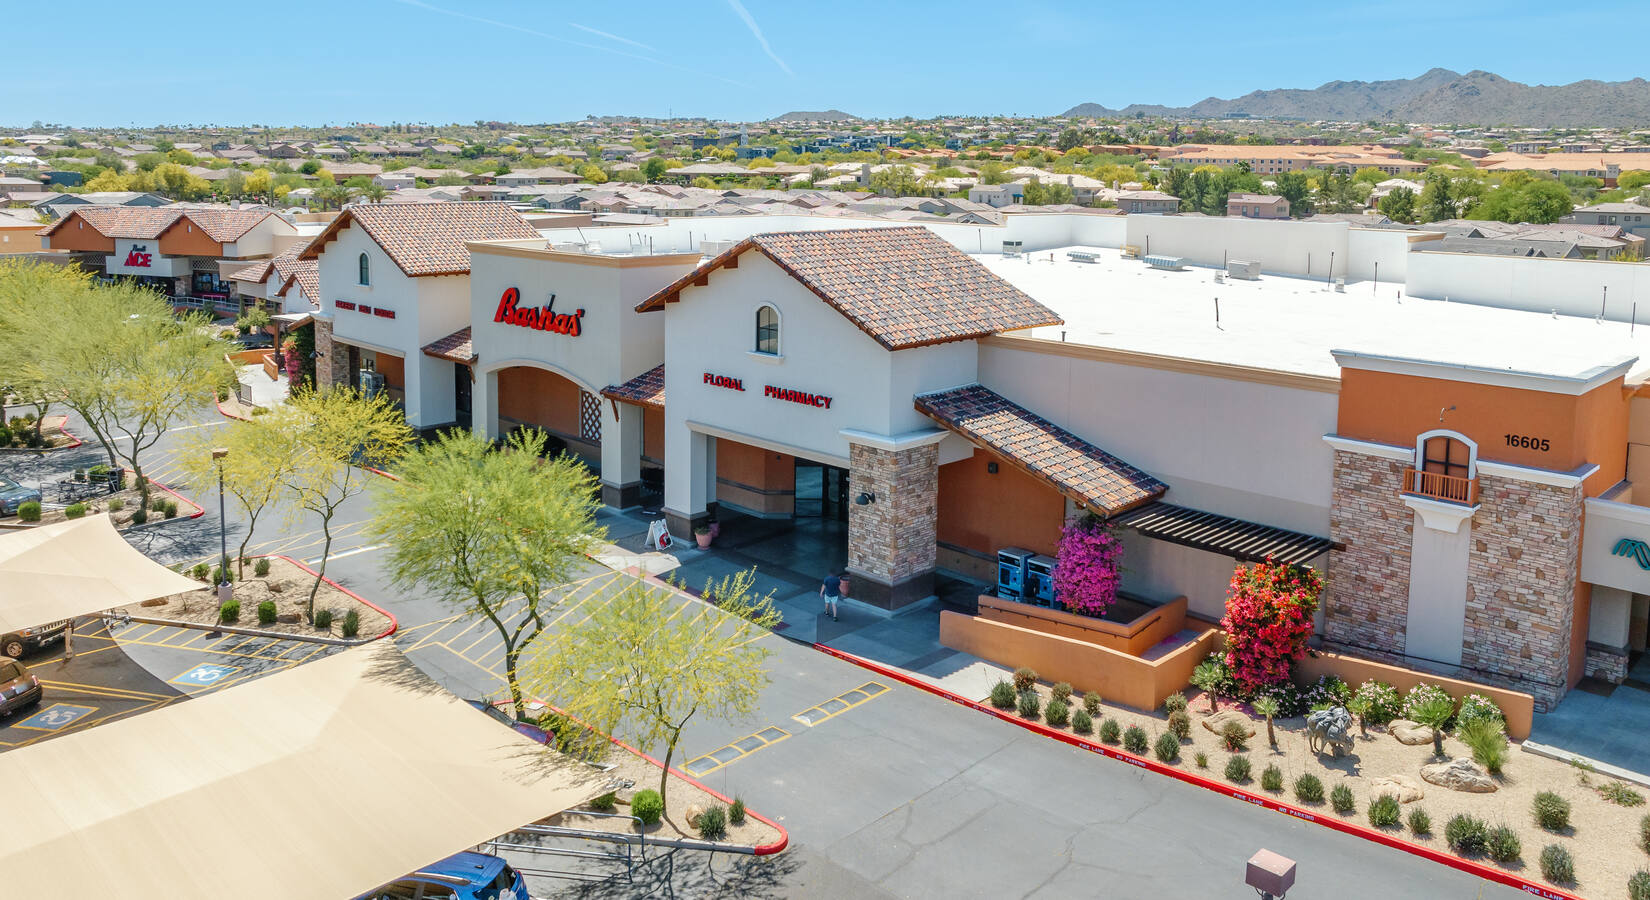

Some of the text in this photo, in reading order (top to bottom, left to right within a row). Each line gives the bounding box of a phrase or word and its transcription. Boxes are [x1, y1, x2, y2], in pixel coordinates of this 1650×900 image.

[124, 250, 152, 267] ACE
[703, 372, 833, 409] FLORAL PHARMACY
[1504, 434, 1550, 452] 16605
[1522, 884, 1540, 895] FIRE
